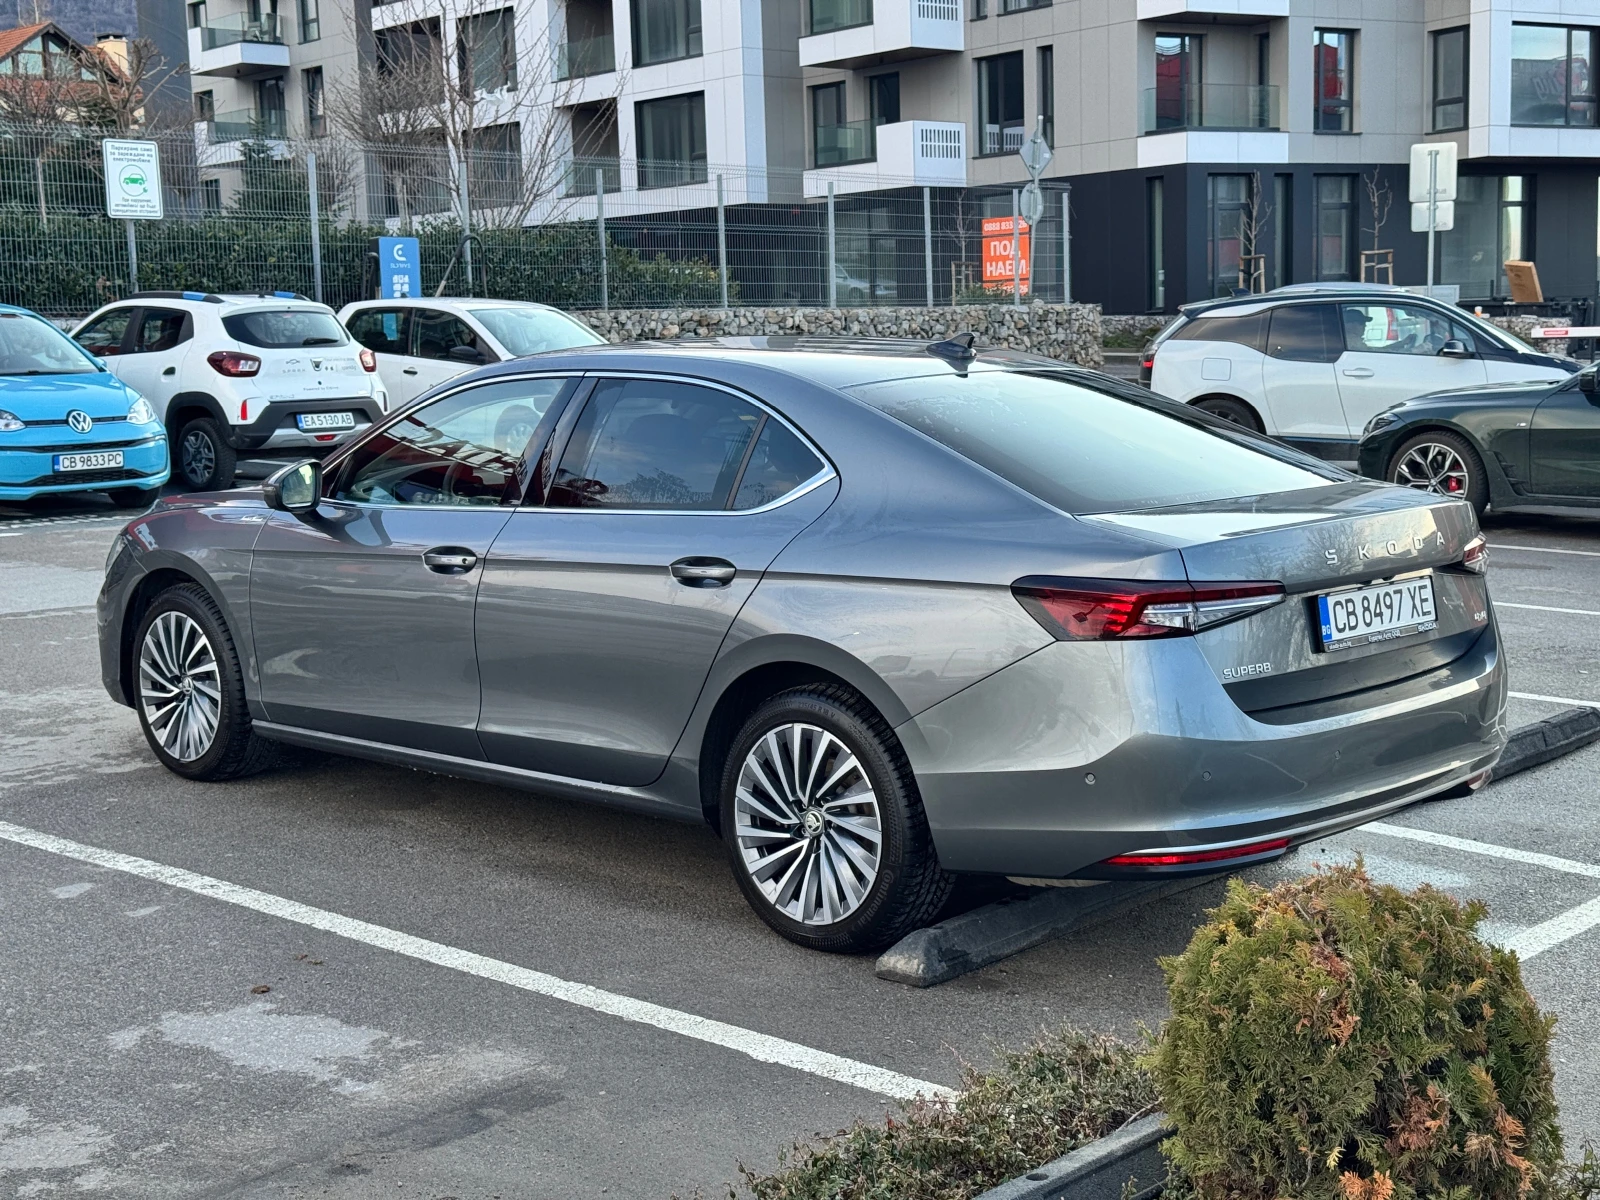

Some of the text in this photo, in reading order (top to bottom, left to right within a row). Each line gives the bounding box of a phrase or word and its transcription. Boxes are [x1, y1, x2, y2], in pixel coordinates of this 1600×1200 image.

[987, 260, 1026, 276] НАЕМ
[303, 416, 317, 427] EA
[317, 415, 339, 426] 5130
[341, 414, 353, 425] AB
[62, 457, 76, 469] CB
[79, 455, 106, 467] 9833
[108, 453, 122, 465] PC
[1333, 584, 1432, 633] CB 8497 XE
[1322, 624, 1331, 636] BG
[1223, 662, 1271, 679] SUPERB
[857, 870, 894, 926] Continental
